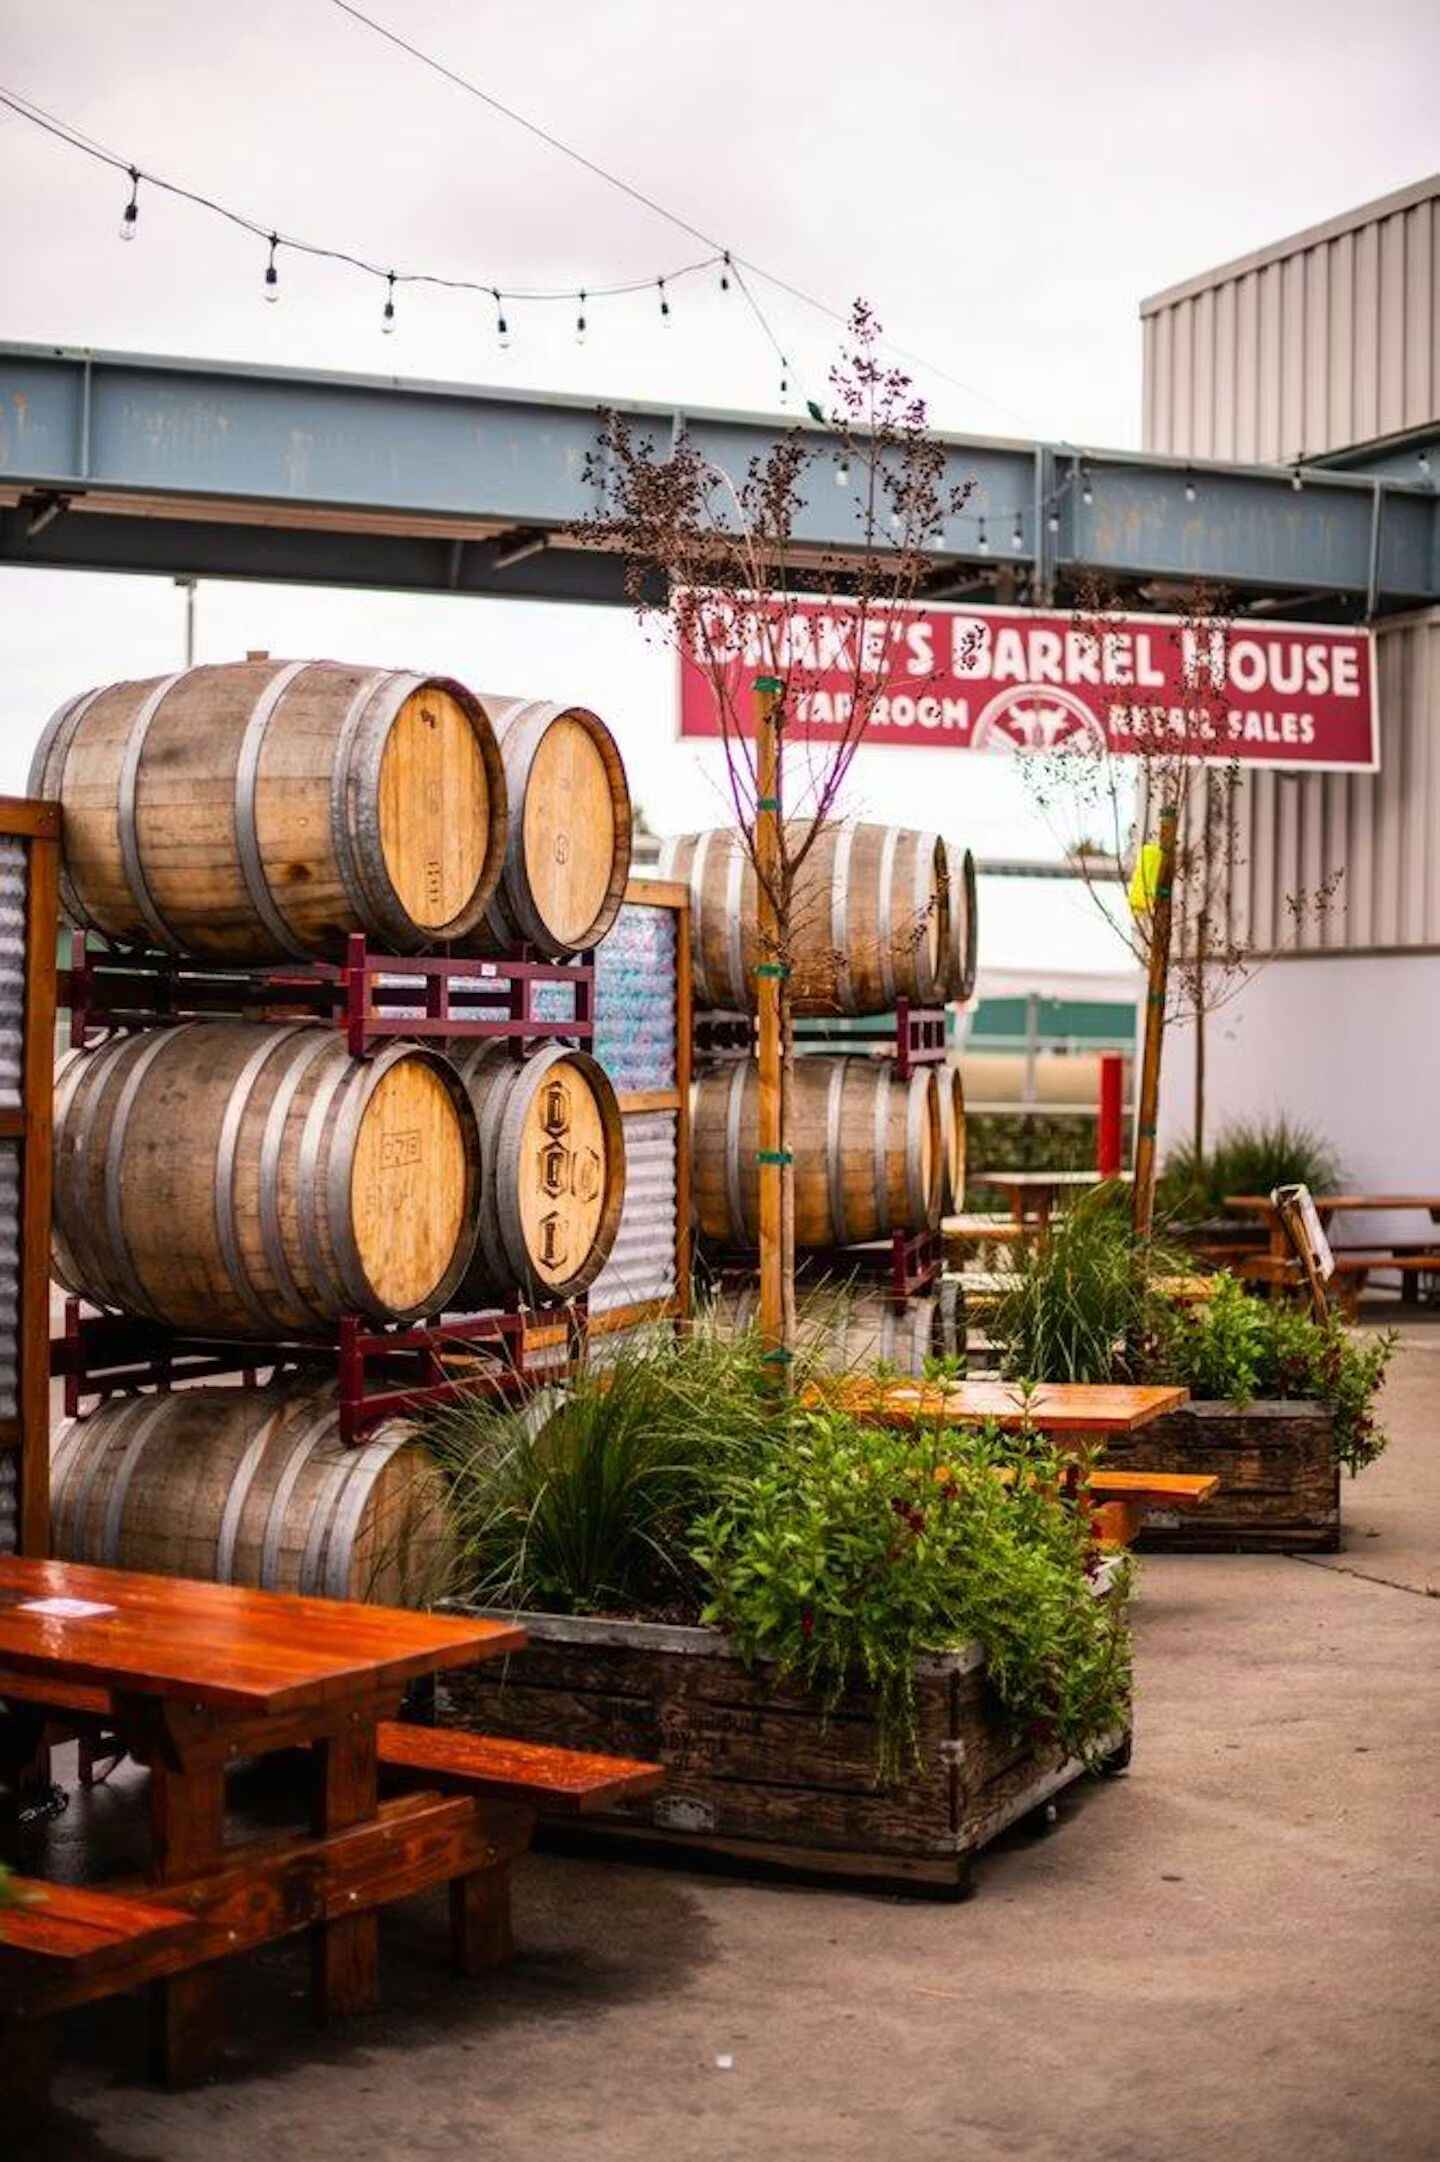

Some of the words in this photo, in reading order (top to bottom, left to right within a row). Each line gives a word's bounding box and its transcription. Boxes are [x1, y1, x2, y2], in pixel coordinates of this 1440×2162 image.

[952, 615, 1166, 687] BARREL
[1180, 627, 1361, 698] HOUSE
[867, 694, 970, 731] ROOM
[1227, 710, 1316, 744] SALES
